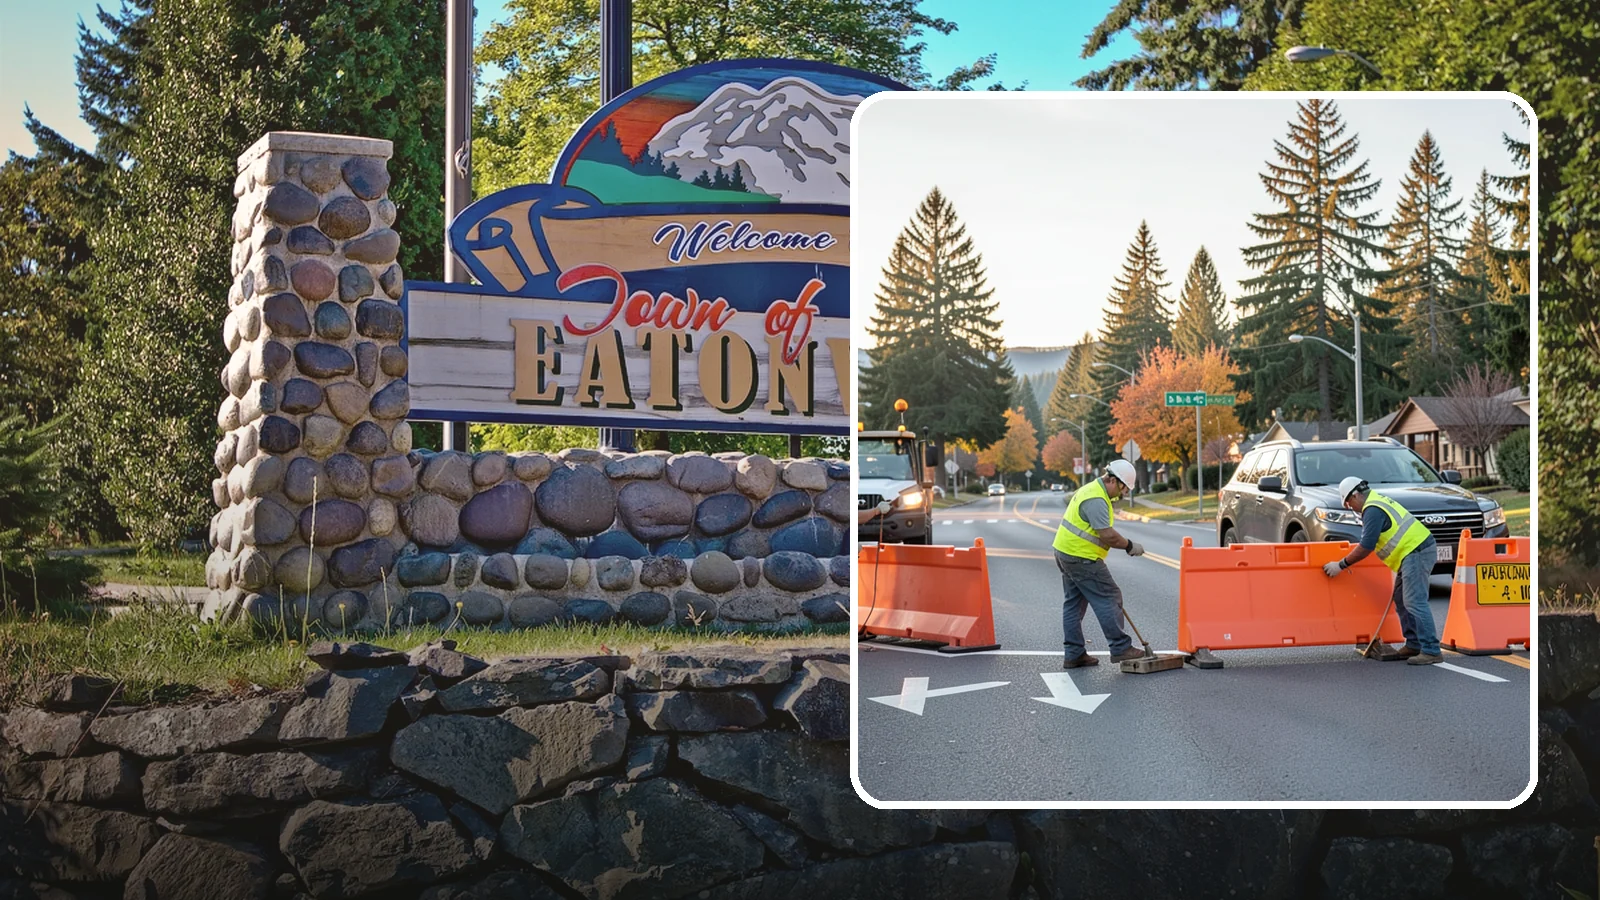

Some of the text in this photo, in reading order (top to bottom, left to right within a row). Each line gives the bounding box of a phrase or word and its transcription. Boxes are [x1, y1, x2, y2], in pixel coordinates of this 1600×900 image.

[653, 220, 837, 264] Welcome
[556, 263, 826, 365] Town of
